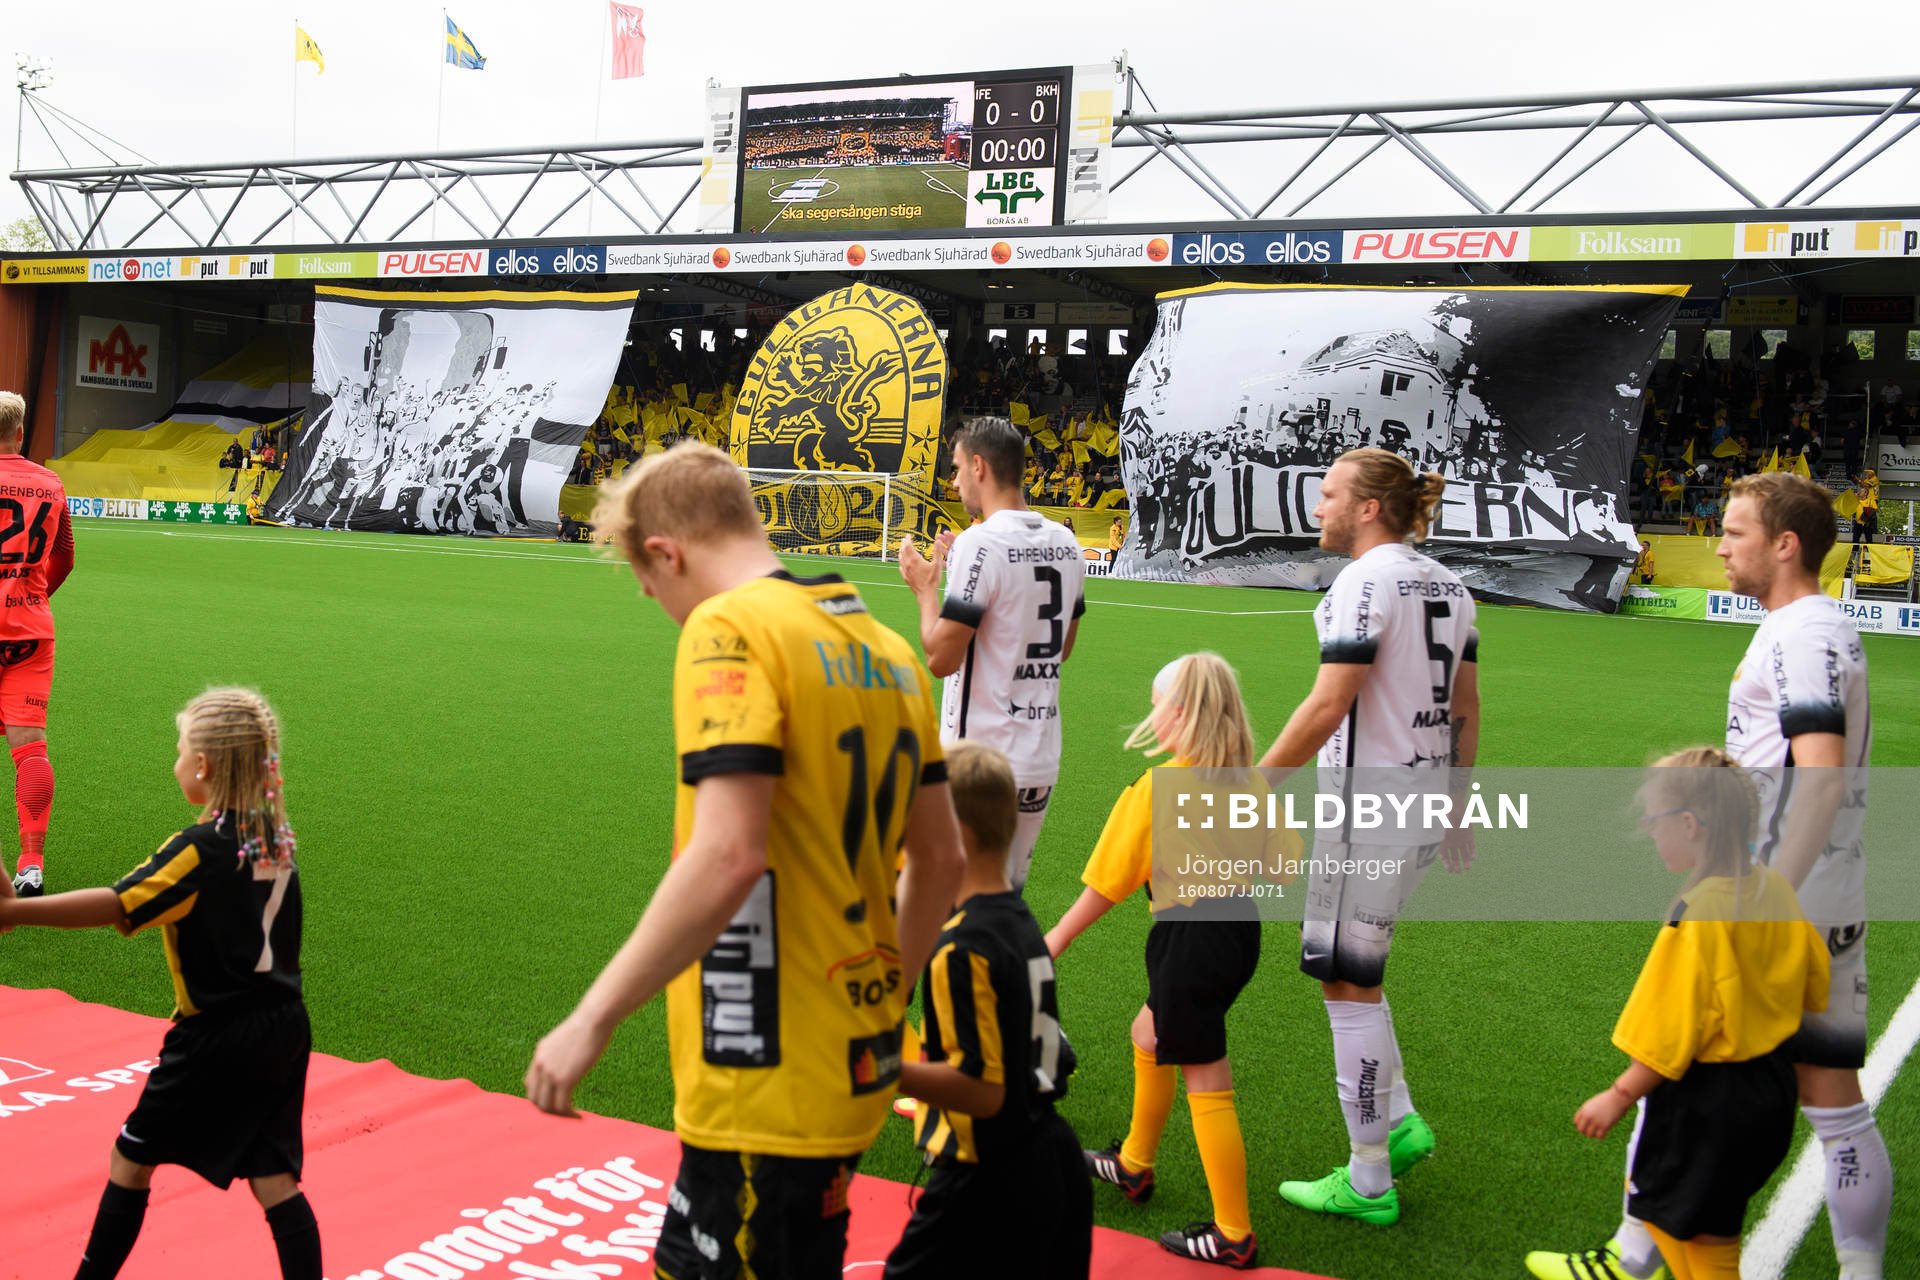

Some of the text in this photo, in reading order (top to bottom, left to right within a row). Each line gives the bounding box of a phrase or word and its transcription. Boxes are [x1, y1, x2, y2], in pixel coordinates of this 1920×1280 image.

[975, 85, 1057, 100] IFE BKH
[986, 102, 1000, 125] 0
[1030, 100, 1044, 123] 0
[981, 138, 1046, 163] 00:00
[986, 171, 1034, 190] LBC
[781, 204, 922, 221] ska segersången stiga
[870, 246, 988, 264] Swedbank Sjuhärad
[1016, 243, 1143, 262] Swedbank Sjuhärad
[1182, 234, 1246, 265] ellos
[1265, 232, 1331, 264] ellos
[1352, 230, 1519, 260] PULSEN
[1577, 230, 1682, 255] Folksam
[299, 257, 352, 275] Folksam
[383, 252, 483, 275] PULSEN
[495, 249, 540, 274] ellos
[552, 248, 599, 273] ellos
[608, 252, 710, 268] Swedbank Sjuhärad
[734, 249, 844, 266] Swedbank Sjuhärad
[23, 265, 86, 276] VI TILLSAMMANS
[88, 323, 149, 378] MAX
[80, 375, 153, 389] HAMBURGARE PÅ SVENSKA
[106, 500, 140, 518] ELIT
[0, 498, 52, 564] 26
[1008, 547, 1077, 564] EHRENBORG
[963, 546, 989, 604] stadium
[1026, 565, 1063, 660] 3
[1356, 580, 1375, 642] stadium
[1838, 603, 1883, 619] BAB
[1424, 599, 1454, 704] 5
[252, 861, 292, 973] 7
[1027, 955, 1060, 1093] 5
[533, 1156, 664, 1213] för
